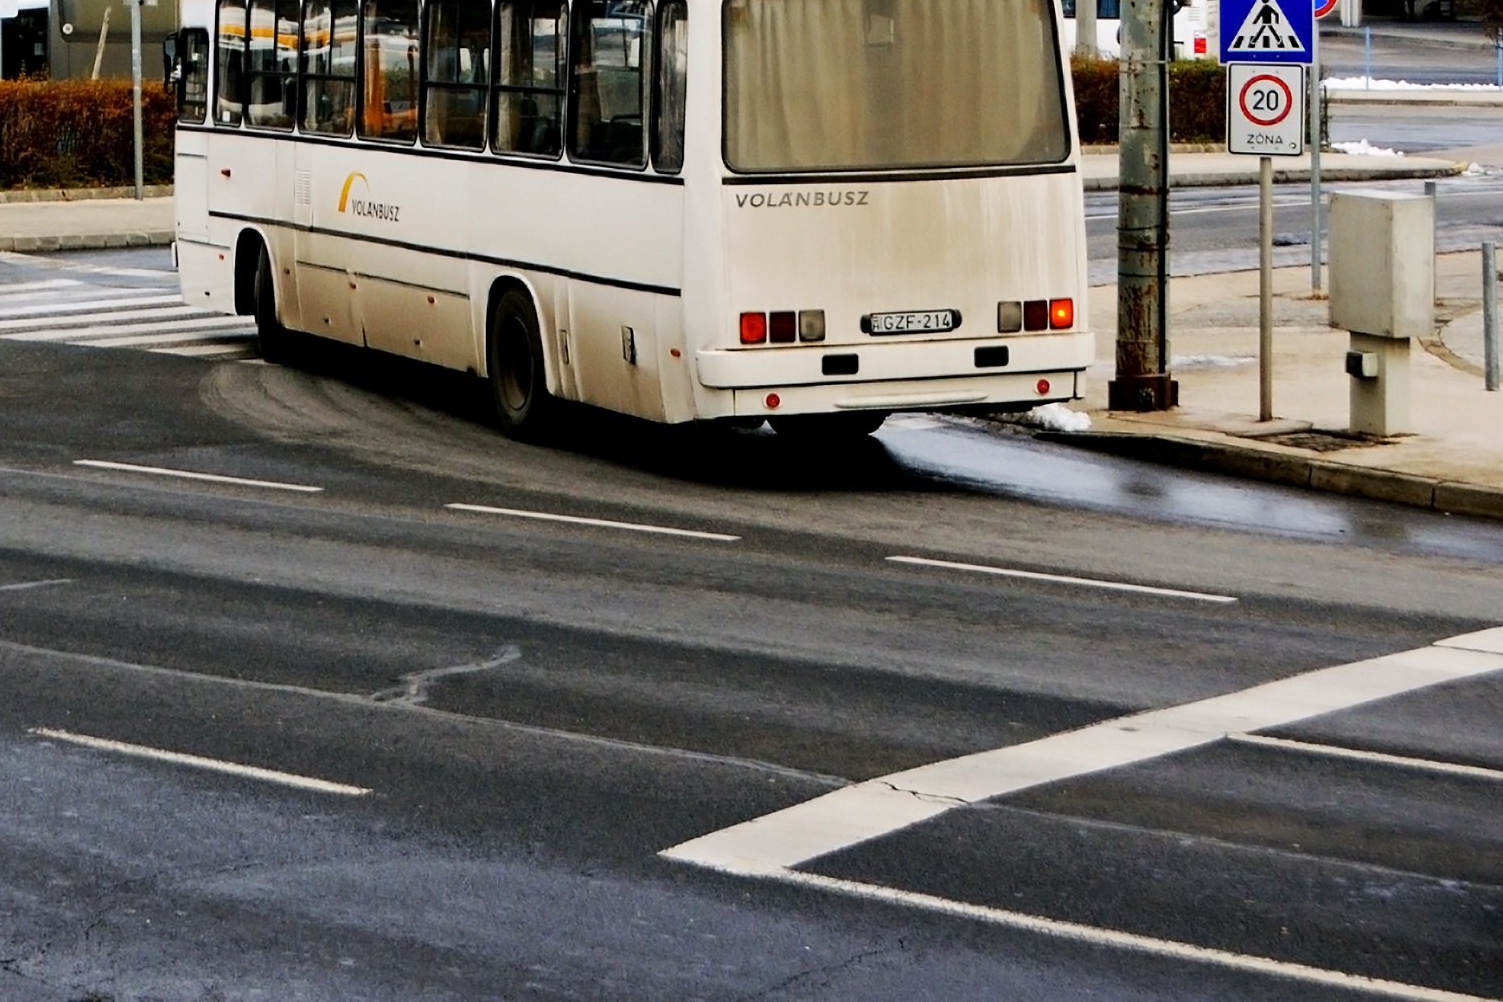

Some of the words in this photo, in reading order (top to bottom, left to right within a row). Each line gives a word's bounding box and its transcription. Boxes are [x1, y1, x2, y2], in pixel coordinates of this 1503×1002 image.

[1252, 89, 1279, 111] 20
[1246, 132, 1284, 145] ZÓNA
[736, 191, 870, 208] VOLÁNBUSZ
[883, 314, 951, 331] GZF-214
